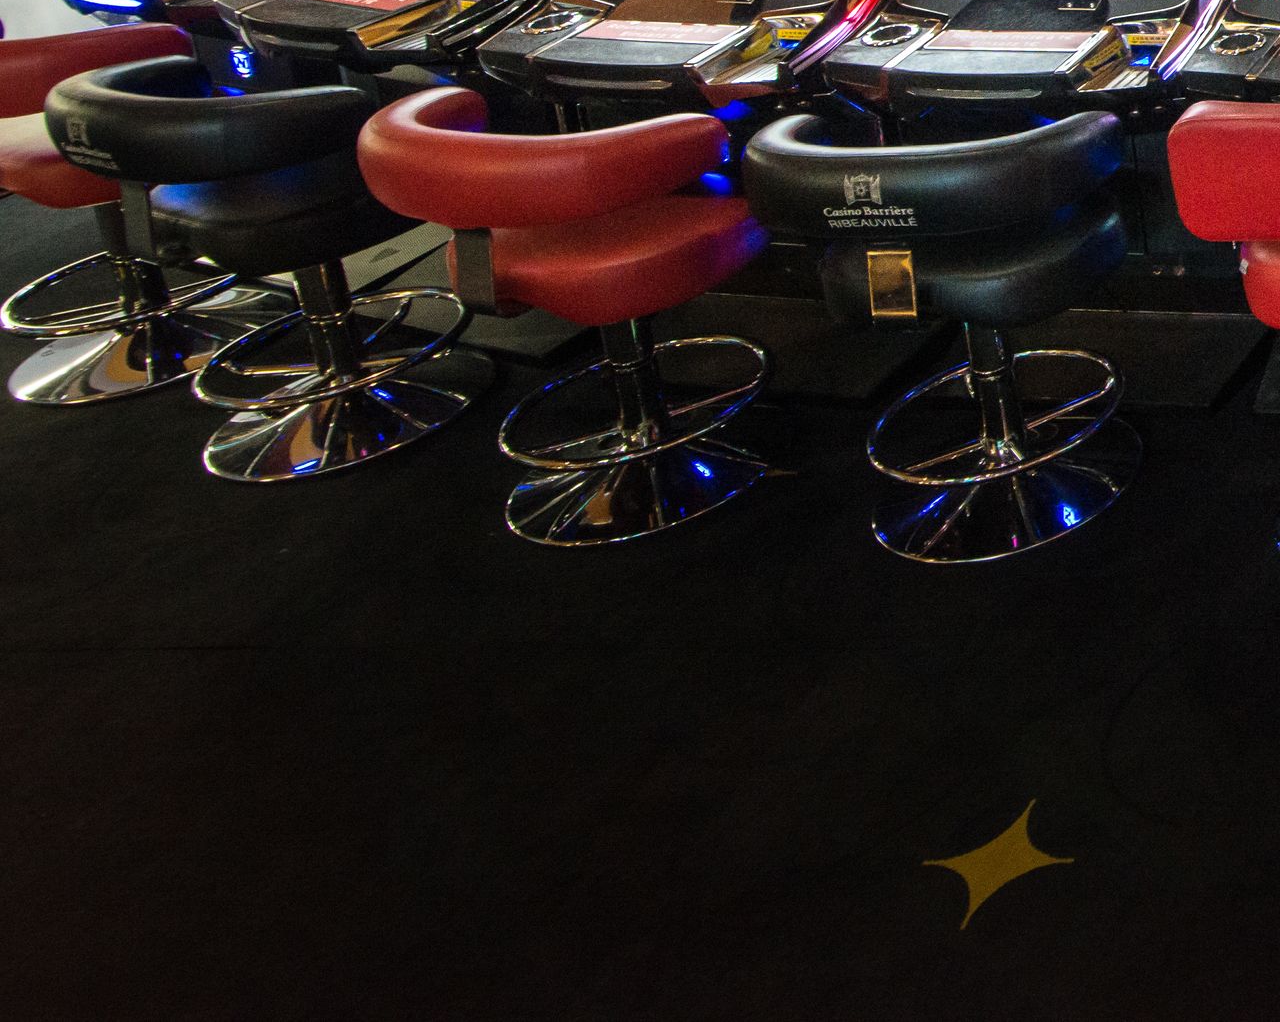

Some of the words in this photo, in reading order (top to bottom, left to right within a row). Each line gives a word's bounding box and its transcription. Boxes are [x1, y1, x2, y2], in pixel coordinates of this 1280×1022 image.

[823, 206, 861, 217] Casino
[864, 205, 914, 217] Barrière
[828, 216, 918, 229] RIBEAUVILLÉ
